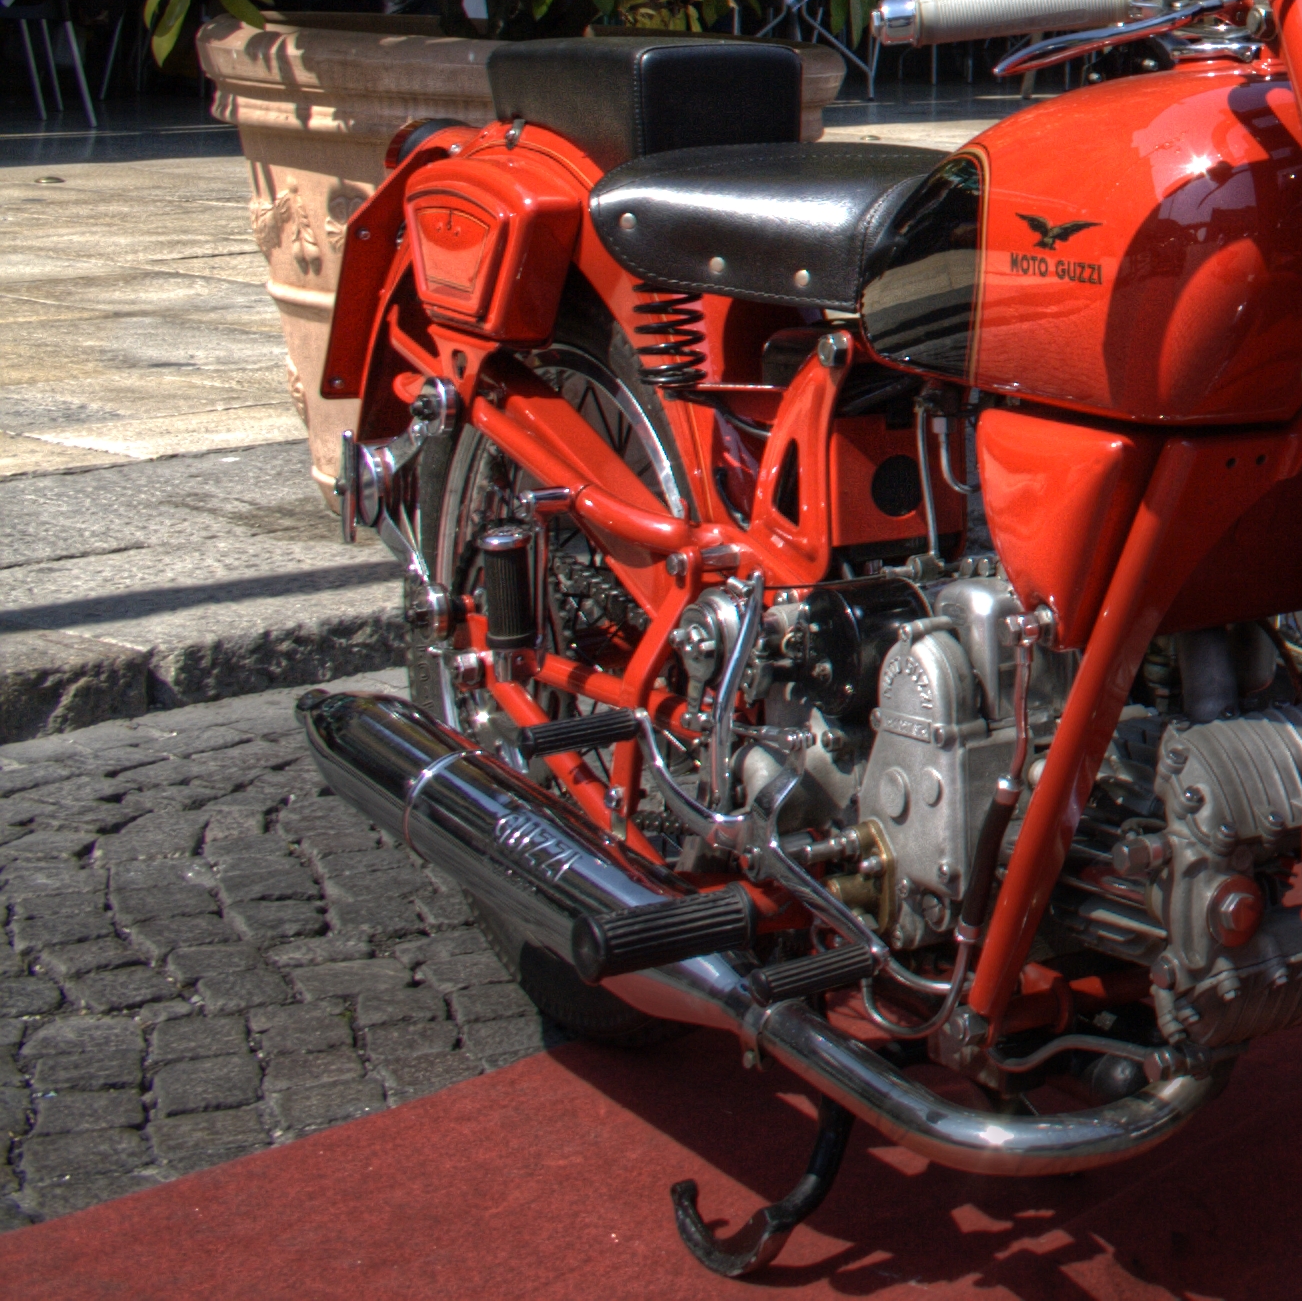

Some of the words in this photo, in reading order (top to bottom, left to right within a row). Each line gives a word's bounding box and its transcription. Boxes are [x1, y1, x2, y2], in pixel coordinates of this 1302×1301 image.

[1010, 251, 1049, 277] MOTO
[1055, 259, 1103, 285] GUZZI
[495, 813, 582, 883] GUZZI
